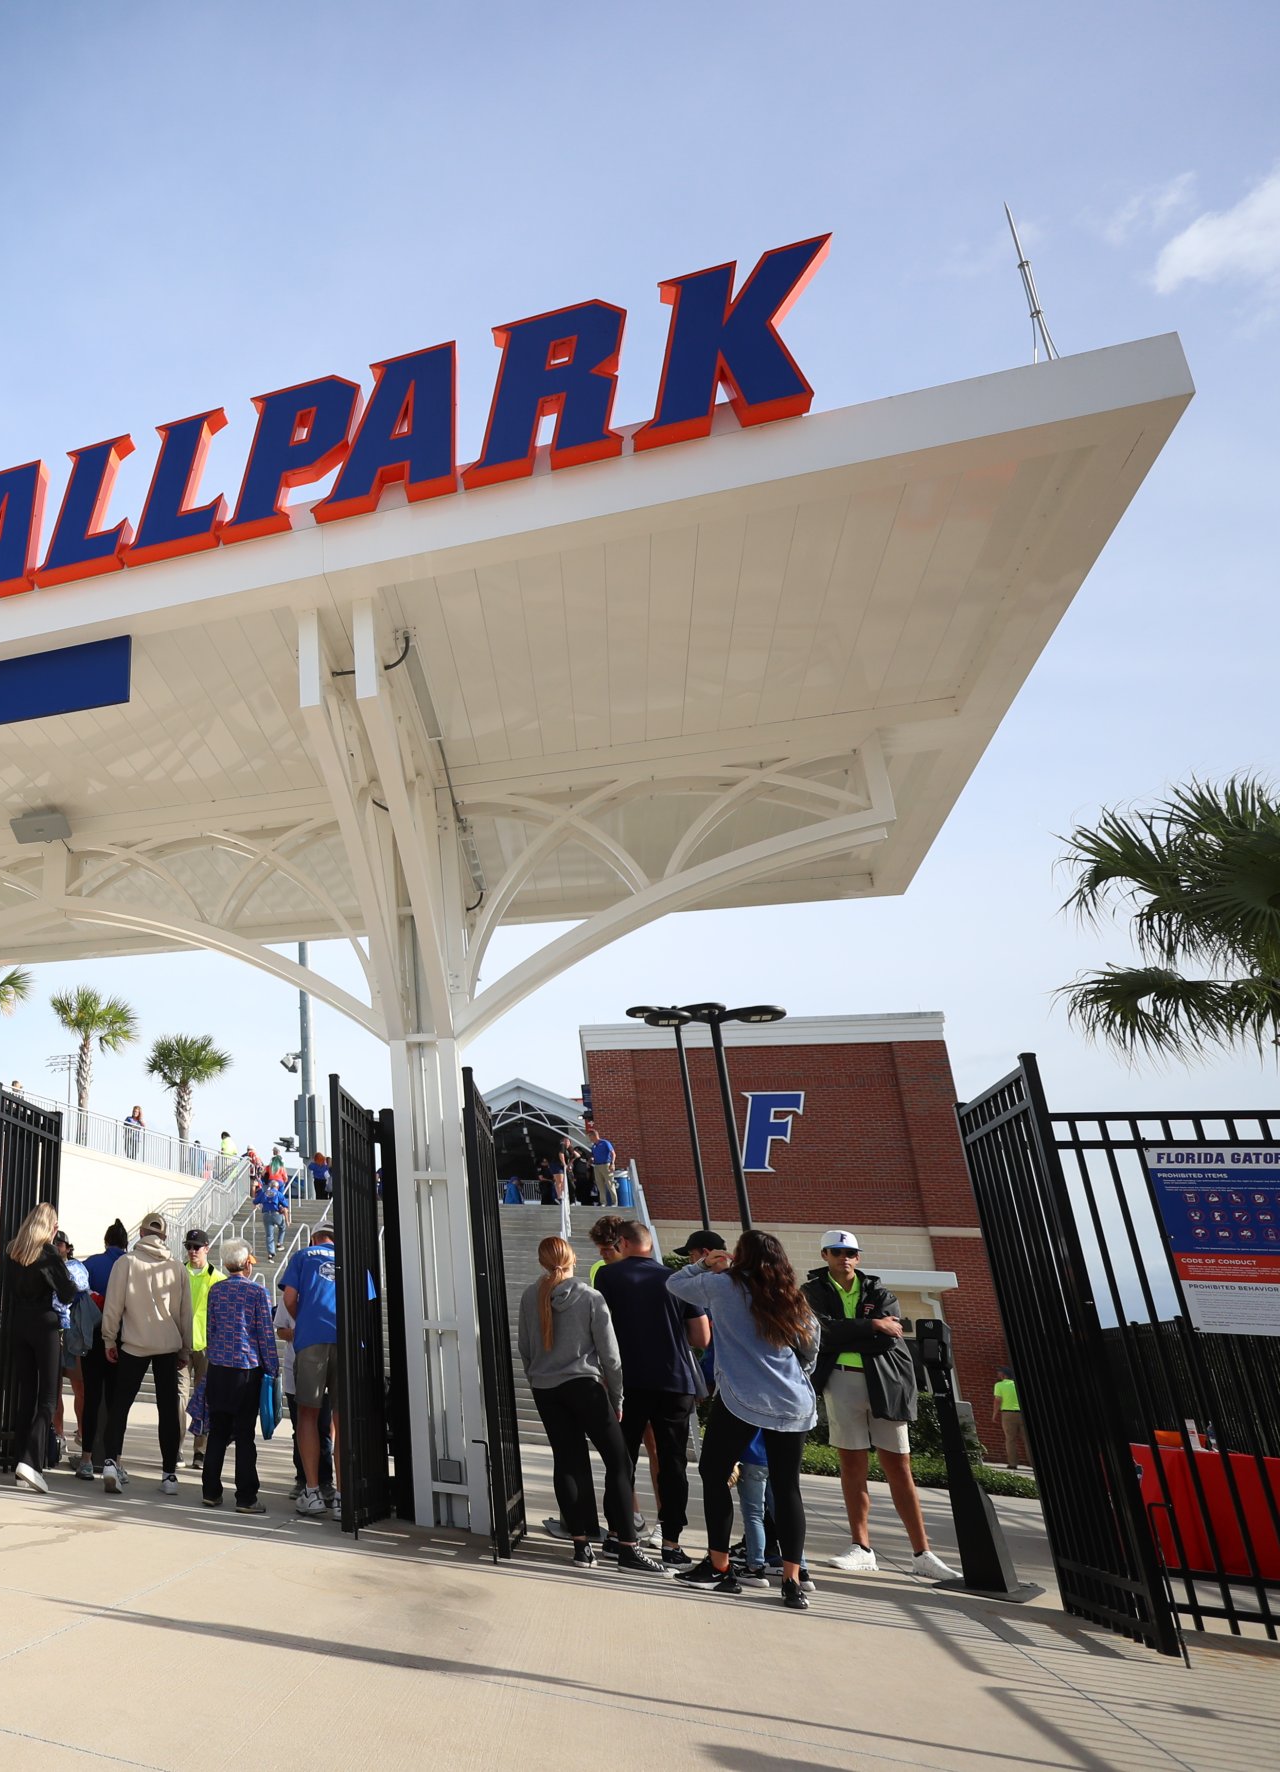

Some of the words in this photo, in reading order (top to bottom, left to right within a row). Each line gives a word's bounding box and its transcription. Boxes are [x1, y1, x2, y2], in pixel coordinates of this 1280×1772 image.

[740, 1091, 805, 1173] F
[1156, 1152, 1225, 1164] FLORIDA
[1188, 1283, 1236, 1291] PROHIBITED
